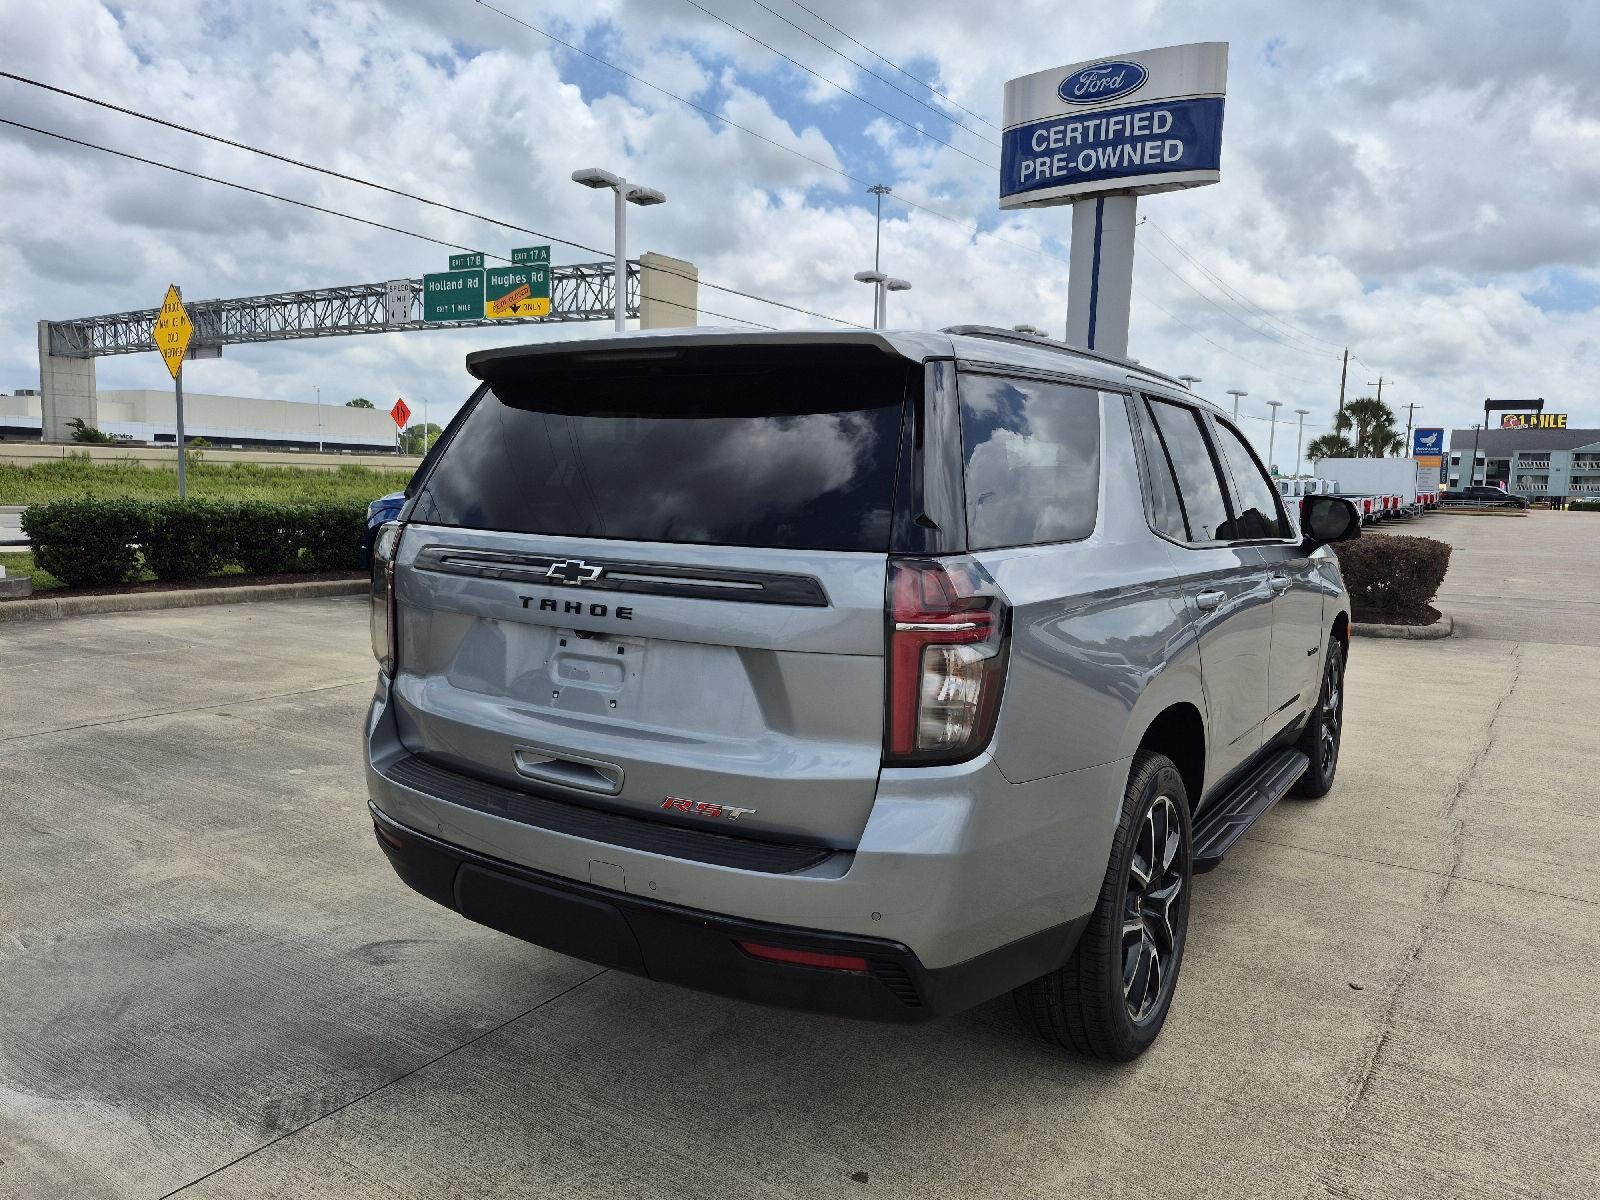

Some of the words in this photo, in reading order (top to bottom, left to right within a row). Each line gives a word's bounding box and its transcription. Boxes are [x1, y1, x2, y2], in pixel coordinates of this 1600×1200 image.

[1074, 67, 1125, 96] Ford
[1031, 110, 1173, 152] CERTIFIED
[1020, 139, 1184, 183] PRE-OWNED
[514, 252, 527, 260] EXIT
[429, 278, 463, 291] Holland
[467, 277, 479, 288] Rd
[491, 273, 527, 287] Hughes
[531, 271, 544, 282] Rd
[390, 284, 409, 292] SPEED
[436, 305, 448, 313] EXIT
[457, 304, 471, 312] MILE
[108, 432, 134, 440] Service
[519, 595, 633, 620] TAHOE
[660, 795, 757, 821] RST
